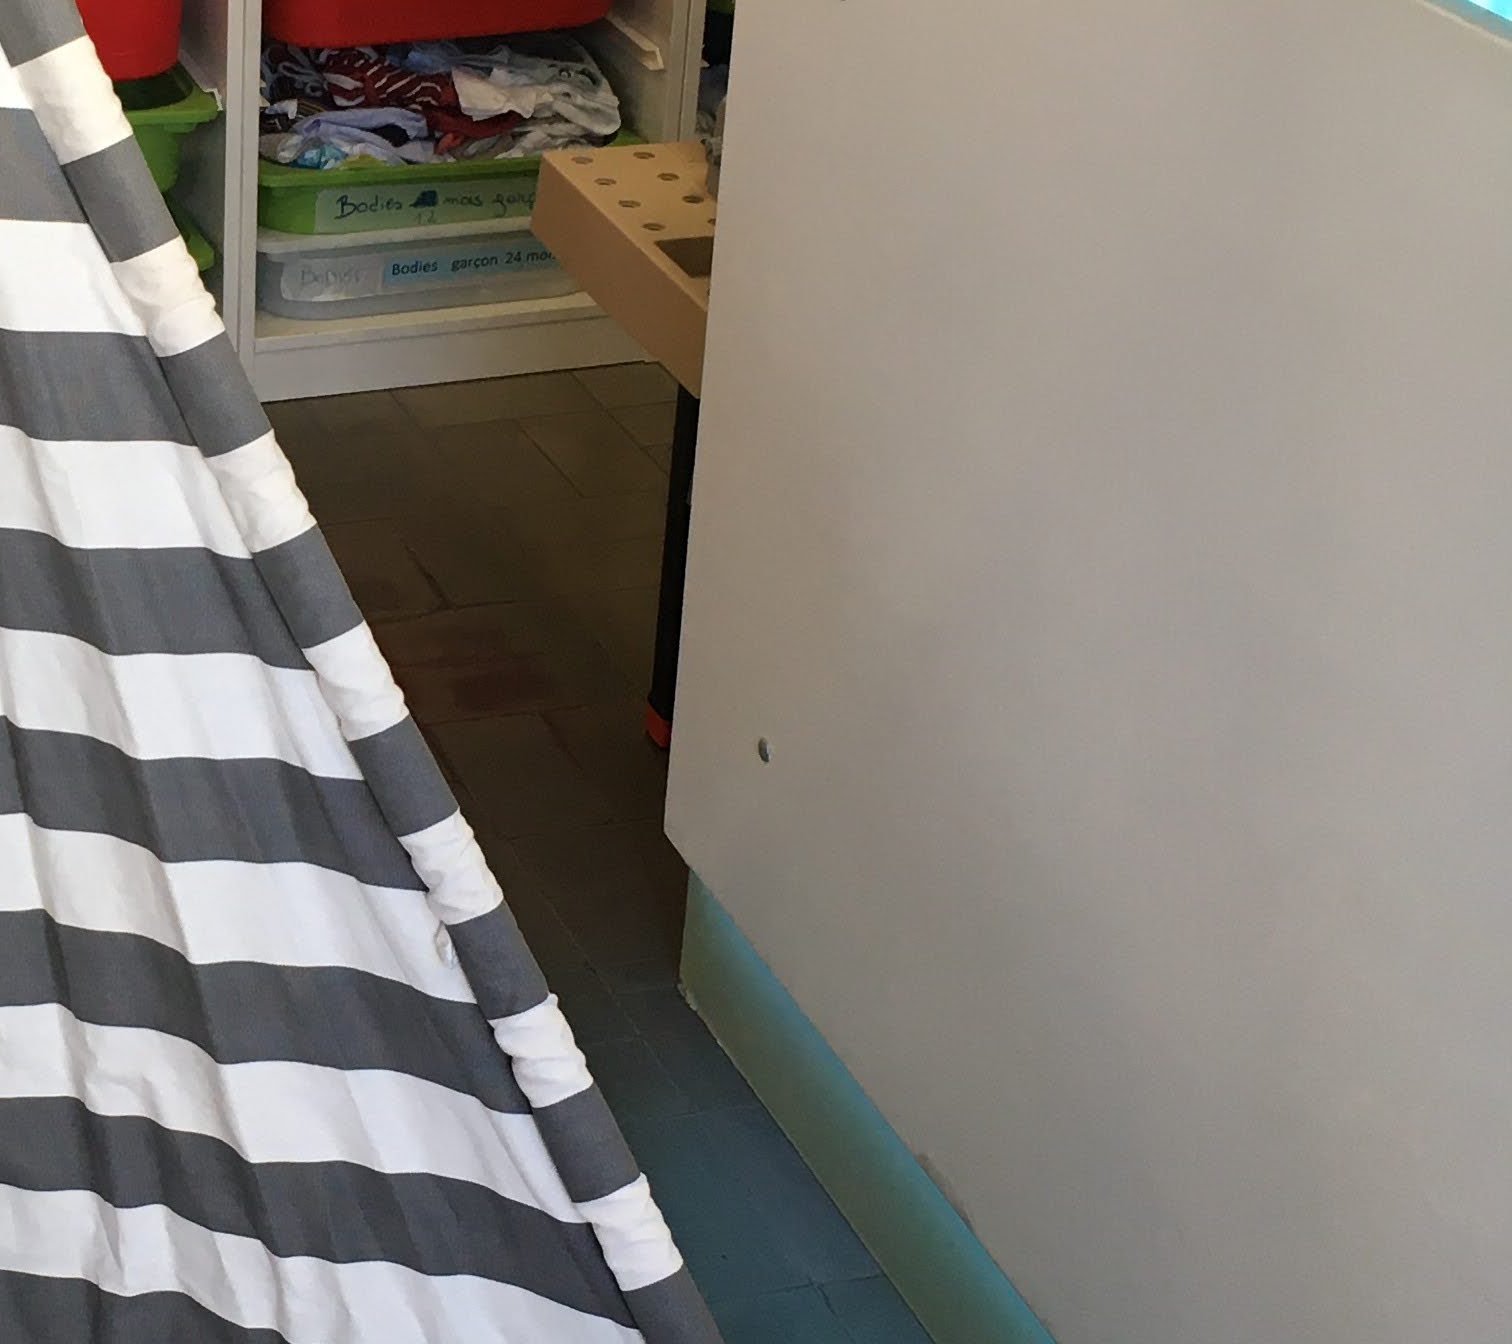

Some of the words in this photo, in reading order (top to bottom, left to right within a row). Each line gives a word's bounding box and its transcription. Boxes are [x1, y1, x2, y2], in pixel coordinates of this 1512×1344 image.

[334, 194, 403, 221] Bodies
[492, 190, 537, 217] garç
[391, 259, 439, 276] Bodies
[450, 255, 499, 273] garçon
[505, 251, 522, 265] 24
